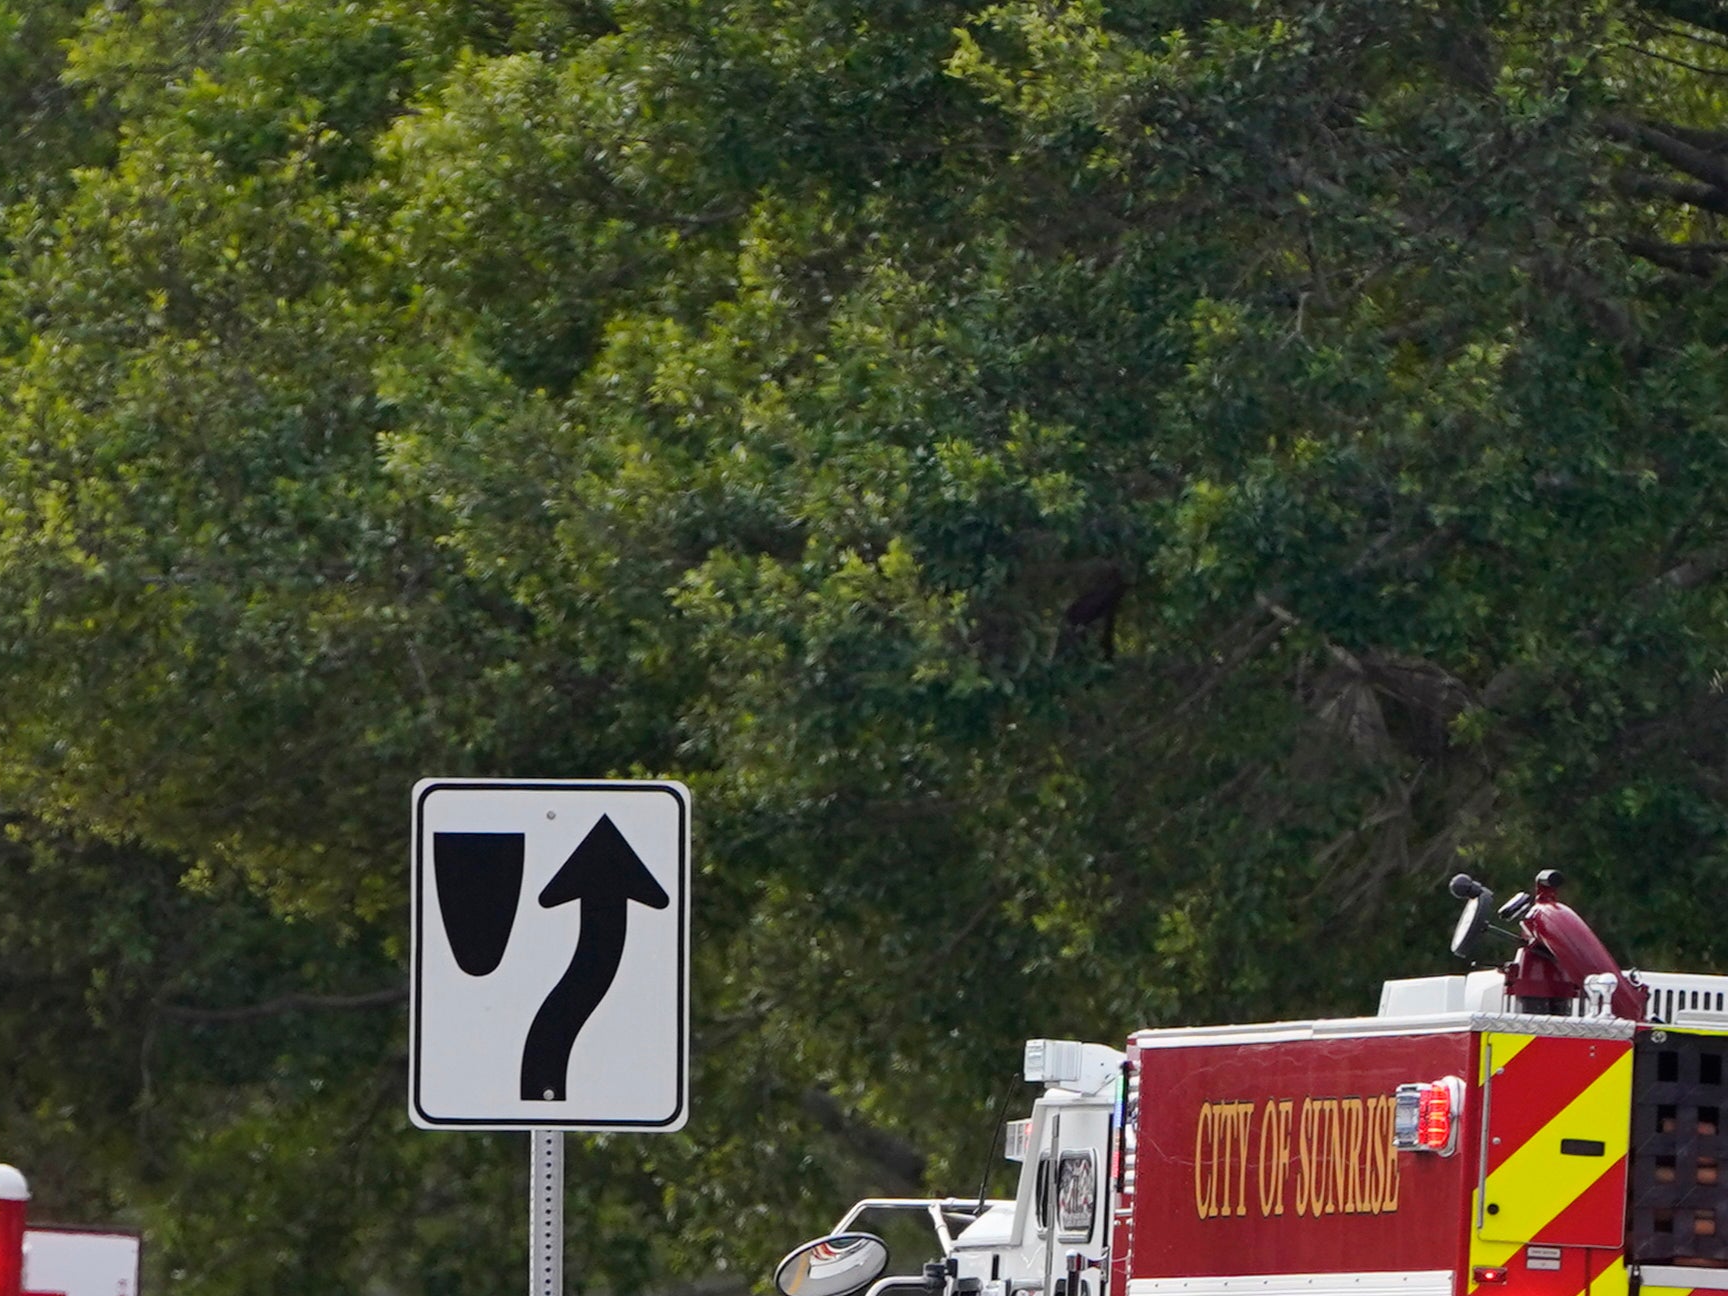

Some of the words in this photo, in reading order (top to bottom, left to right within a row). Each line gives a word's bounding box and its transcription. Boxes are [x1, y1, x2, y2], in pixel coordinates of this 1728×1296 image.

[1195, 1100, 1255, 1220] CITY
[1259, 1098, 1293, 1218] OF
[1296, 1094, 1401, 1216] SUNRISE
